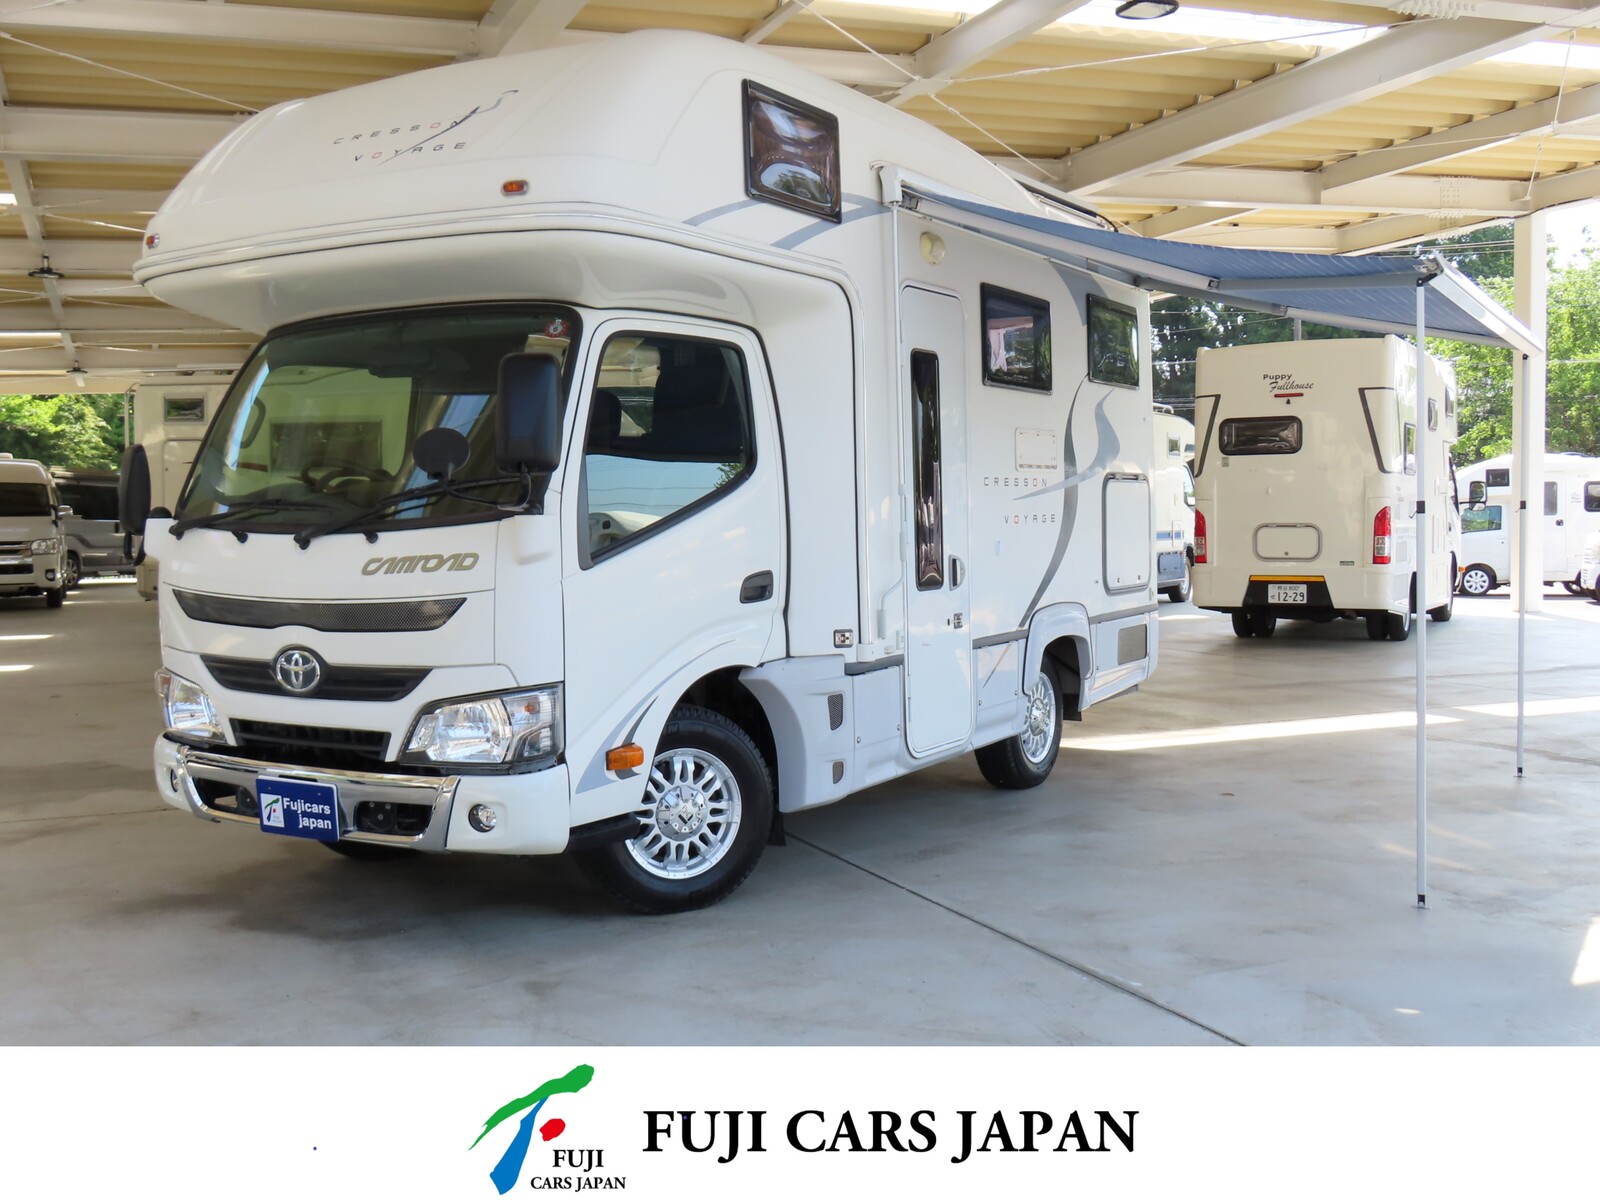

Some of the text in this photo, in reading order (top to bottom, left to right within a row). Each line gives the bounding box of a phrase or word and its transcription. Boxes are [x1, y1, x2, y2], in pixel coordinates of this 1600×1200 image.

[333, 120, 460, 145] CRESSON
[354, 142, 466, 162] VOYAGE
[1263, 373, 1292, 381] Puppy
[1269, 380, 1314, 393] Fullhouse
[983, 476, 1047, 488] CRESSON
[1004, 513, 1056, 525] VOYAGE
[1277, 591, 1305, 602] 12-29
[283, 797, 331, 815] Fujicars
[299, 813, 332, 830] japan
